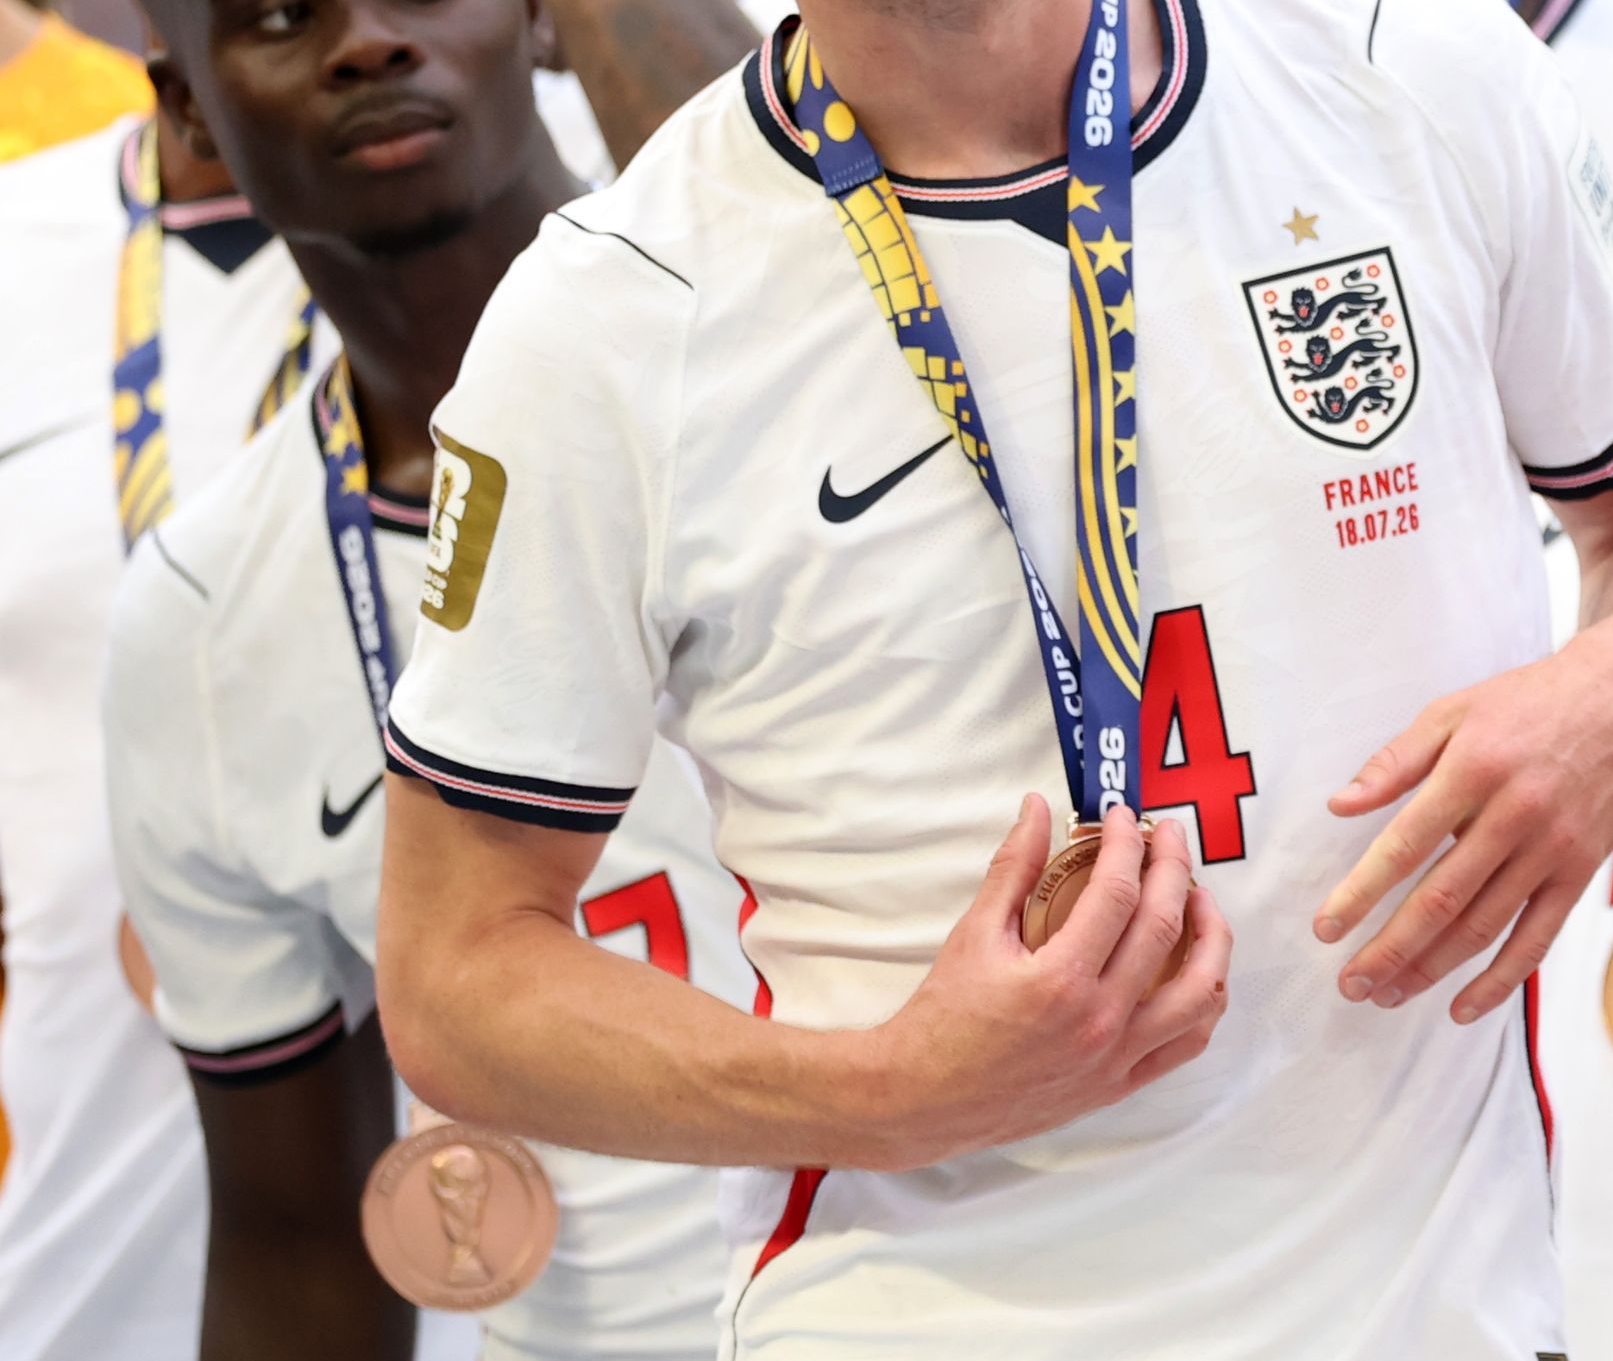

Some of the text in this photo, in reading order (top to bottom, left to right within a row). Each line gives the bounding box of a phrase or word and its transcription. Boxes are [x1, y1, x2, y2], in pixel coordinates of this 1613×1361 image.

[1084, 28, 1117, 148] 2026
[1323, 462, 1420, 511] FRANCE
[1335, 503, 1420, 549] 18.07.26
[1052, 645, 1083, 719] CUP
[1099, 726, 1127, 816] 026
[1139, 603, 1257, 866] 4
